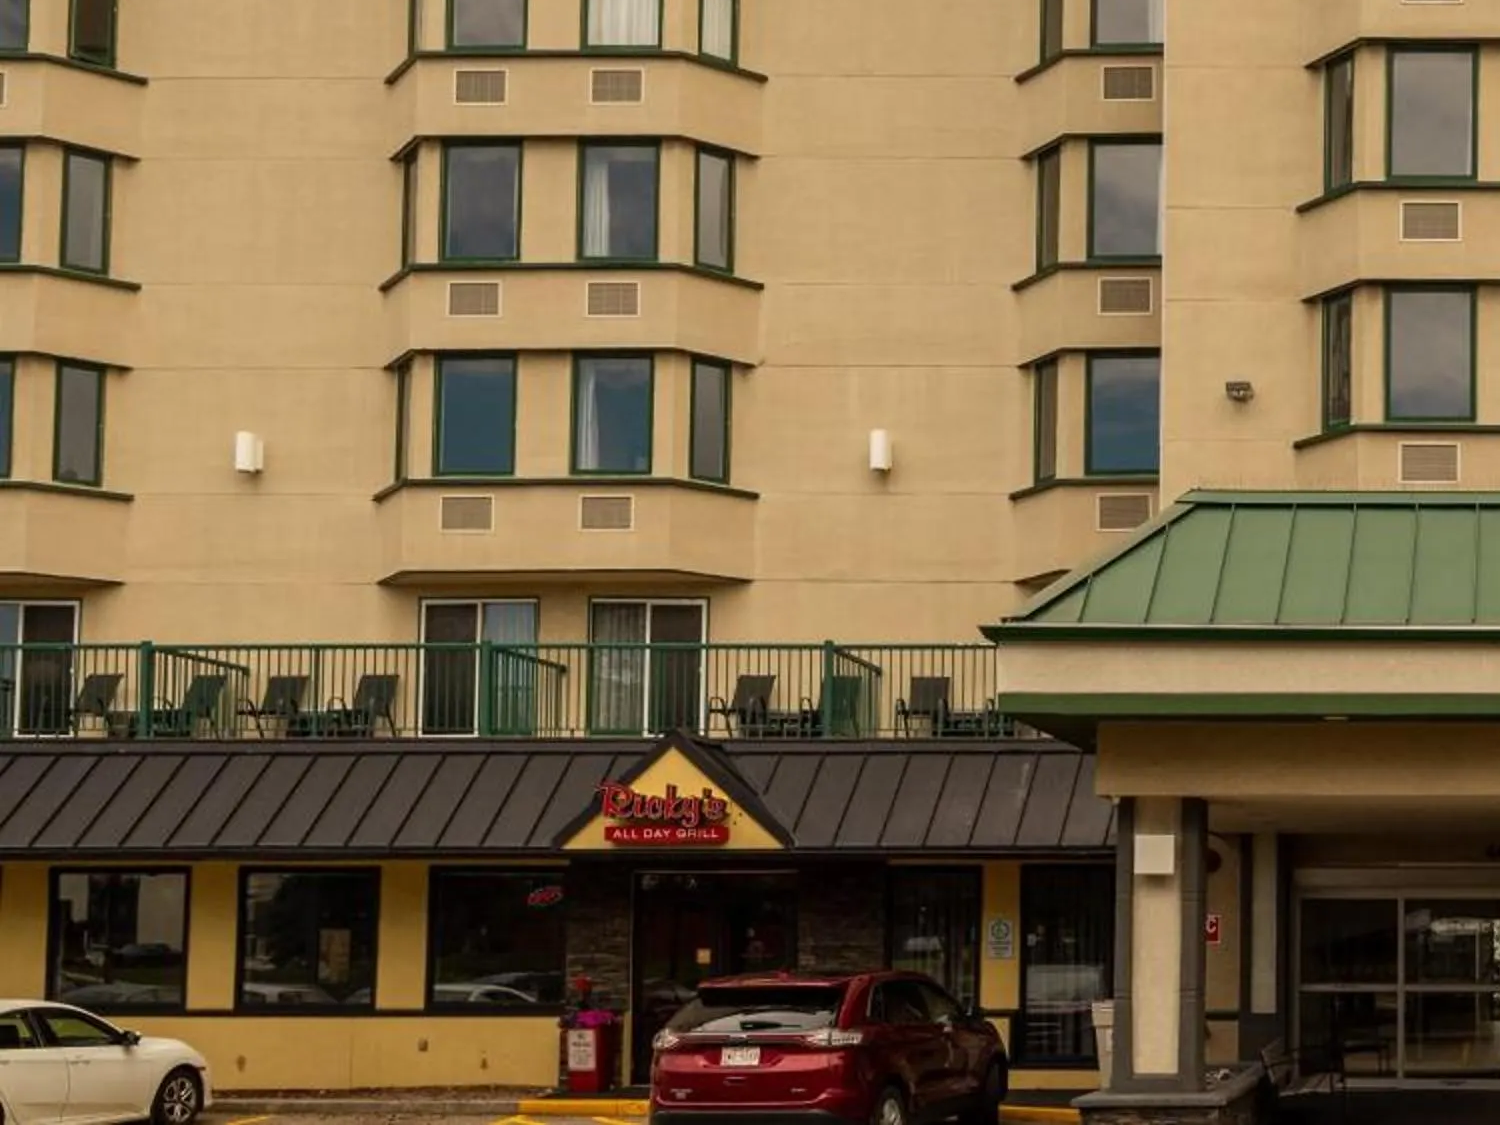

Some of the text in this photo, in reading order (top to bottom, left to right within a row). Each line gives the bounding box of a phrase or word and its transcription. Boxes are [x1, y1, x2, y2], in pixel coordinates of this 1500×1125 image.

[612, 828, 719, 839] ALL DAY GRILL
